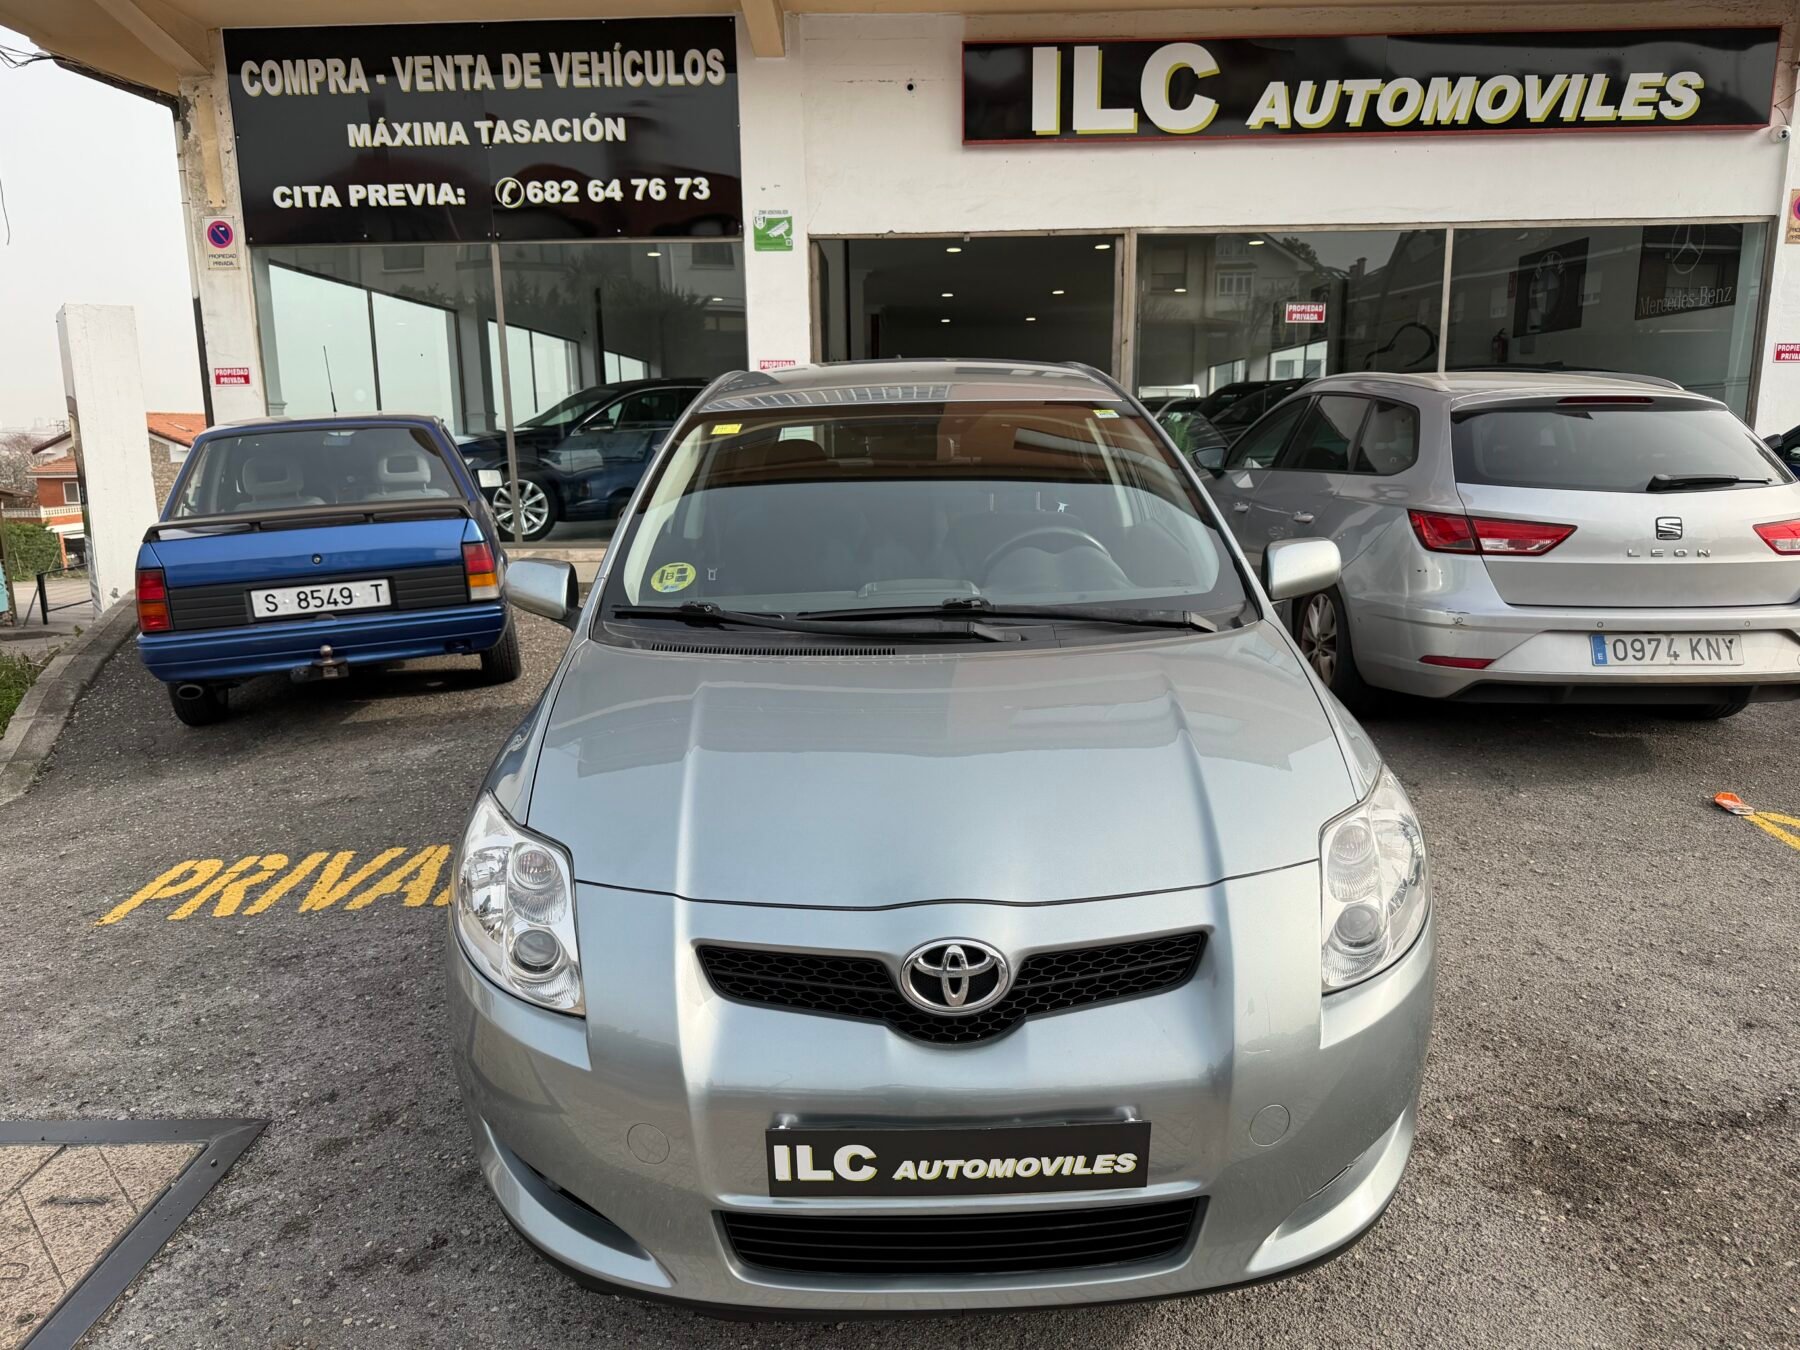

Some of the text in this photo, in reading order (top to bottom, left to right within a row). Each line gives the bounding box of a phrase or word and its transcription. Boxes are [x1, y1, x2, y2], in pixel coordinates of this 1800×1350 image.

[241, 57, 370, 97] COMPRA
[392, 54, 495, 93] VENTA
[501, 52, 543, 90] DE
[549, 41, 726, 89] VEHÍCULOS
[1032, 42, 1704, 136] ILC AUTOMOVILES
[347, 112, 627, 148] MÁXIMA TASACIÓN
[272, 182, 467, 208] CITA PREVIA:
[526, 176, 711, 204] 682 64 76 73
[1288, 304, 1323, 312] PROPIEDAD
[1639, 286, 1733, 316] Mercedes-Benz
[1292, 313, 1318, 321] PRIVADA
[215, 368, 248, 376] PROPIEDAD
[220, 376, 246, 384] PRIVADA
[1627, 548, 1711, 558] LEON
[264, 583, 383, 613] S 8549 T
[1612, 638, 1680, 662] 0974
[1688, 637, 1735, 661] KNY
[95, 844, 452, 927] PRIVA
[773, 1144, 1138, 1182] ILC AUTOMOVILES
